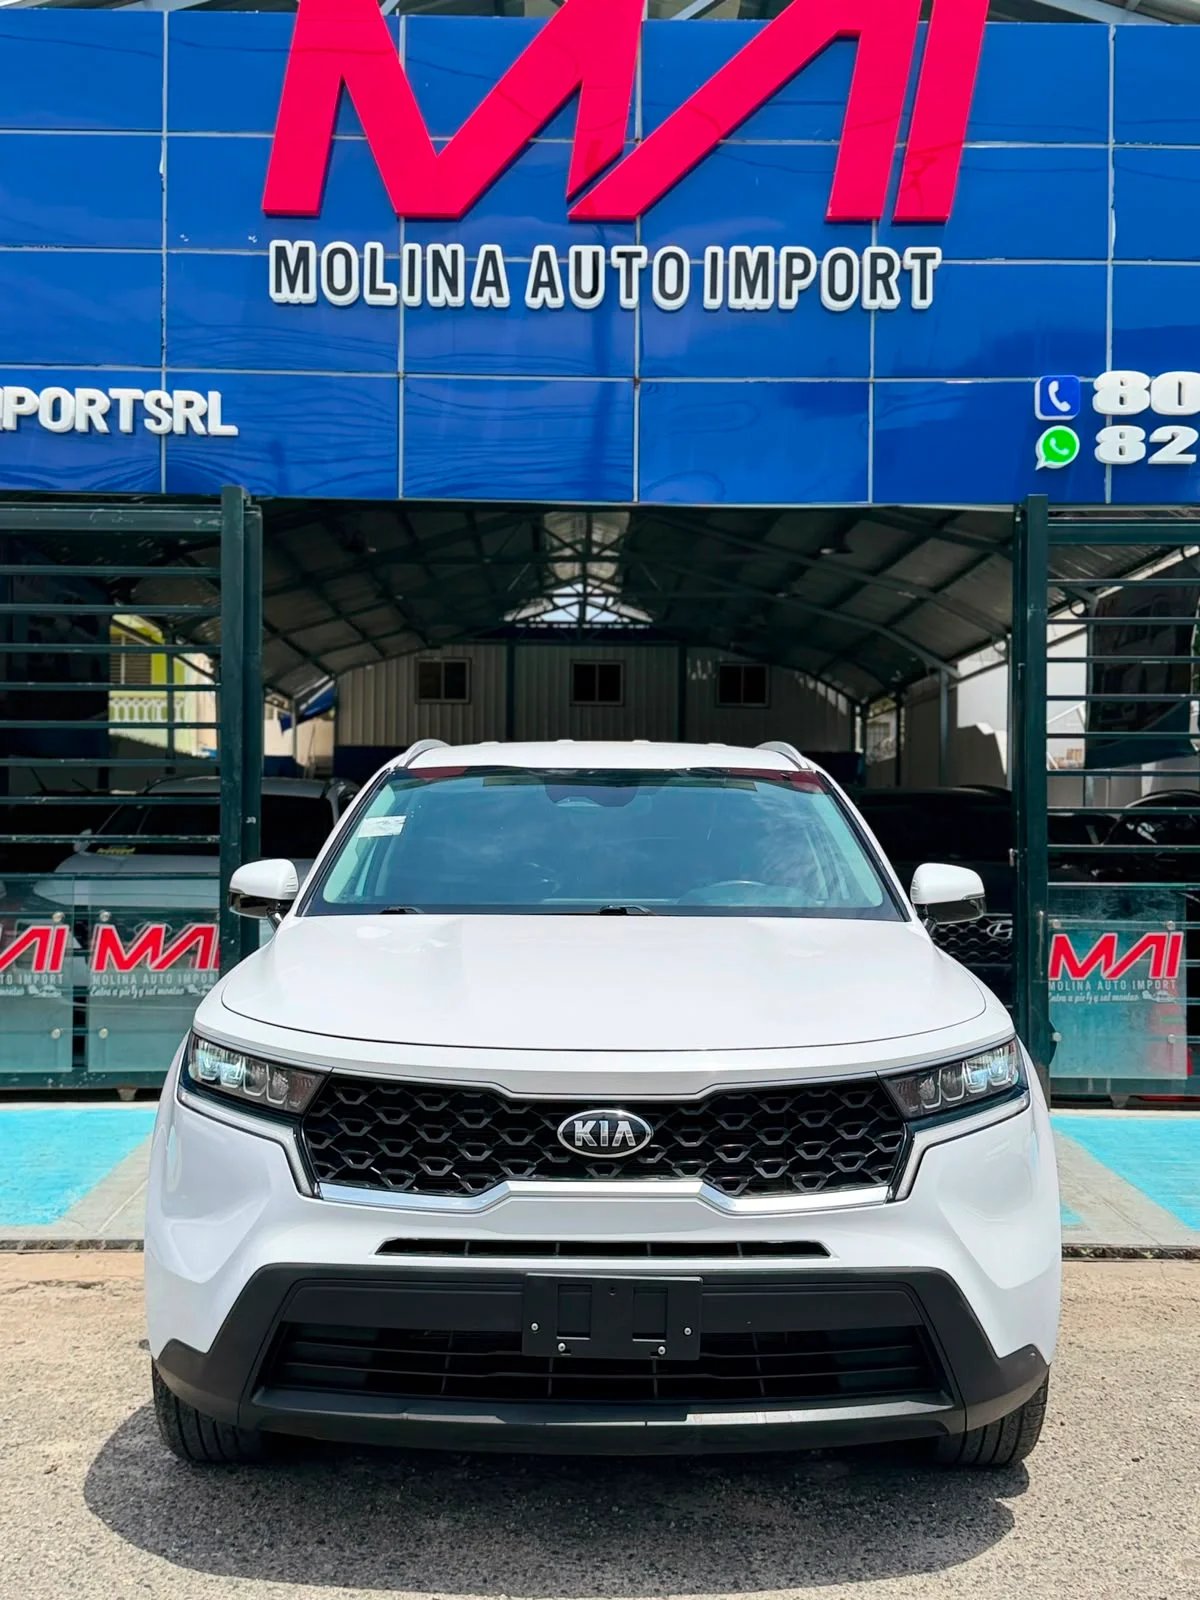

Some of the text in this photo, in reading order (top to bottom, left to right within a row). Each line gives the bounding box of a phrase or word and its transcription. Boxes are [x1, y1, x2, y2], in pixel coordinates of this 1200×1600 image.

[262, 0, 987, 221] MAI
[269, 240, 942, 311] MOLINA AUTO IMPORT
[0, 386, 239, 436] PORTSRL
[1092, 370, 1200, 416] 80
[1094, 425, 1199, 464] 82
[0, 925, 69, 973] AI
[1048, 932, 1184, 980] MAI
[19, 974, 63, 985] IMPORT
[92, 974, 137, 985] MOLINA
[143, 973, 173, 984] AUTO
[1048, 980, 1177, 991] MOLINA AUTO IMPORT
[573, 1120, 637, 1148] KIA
